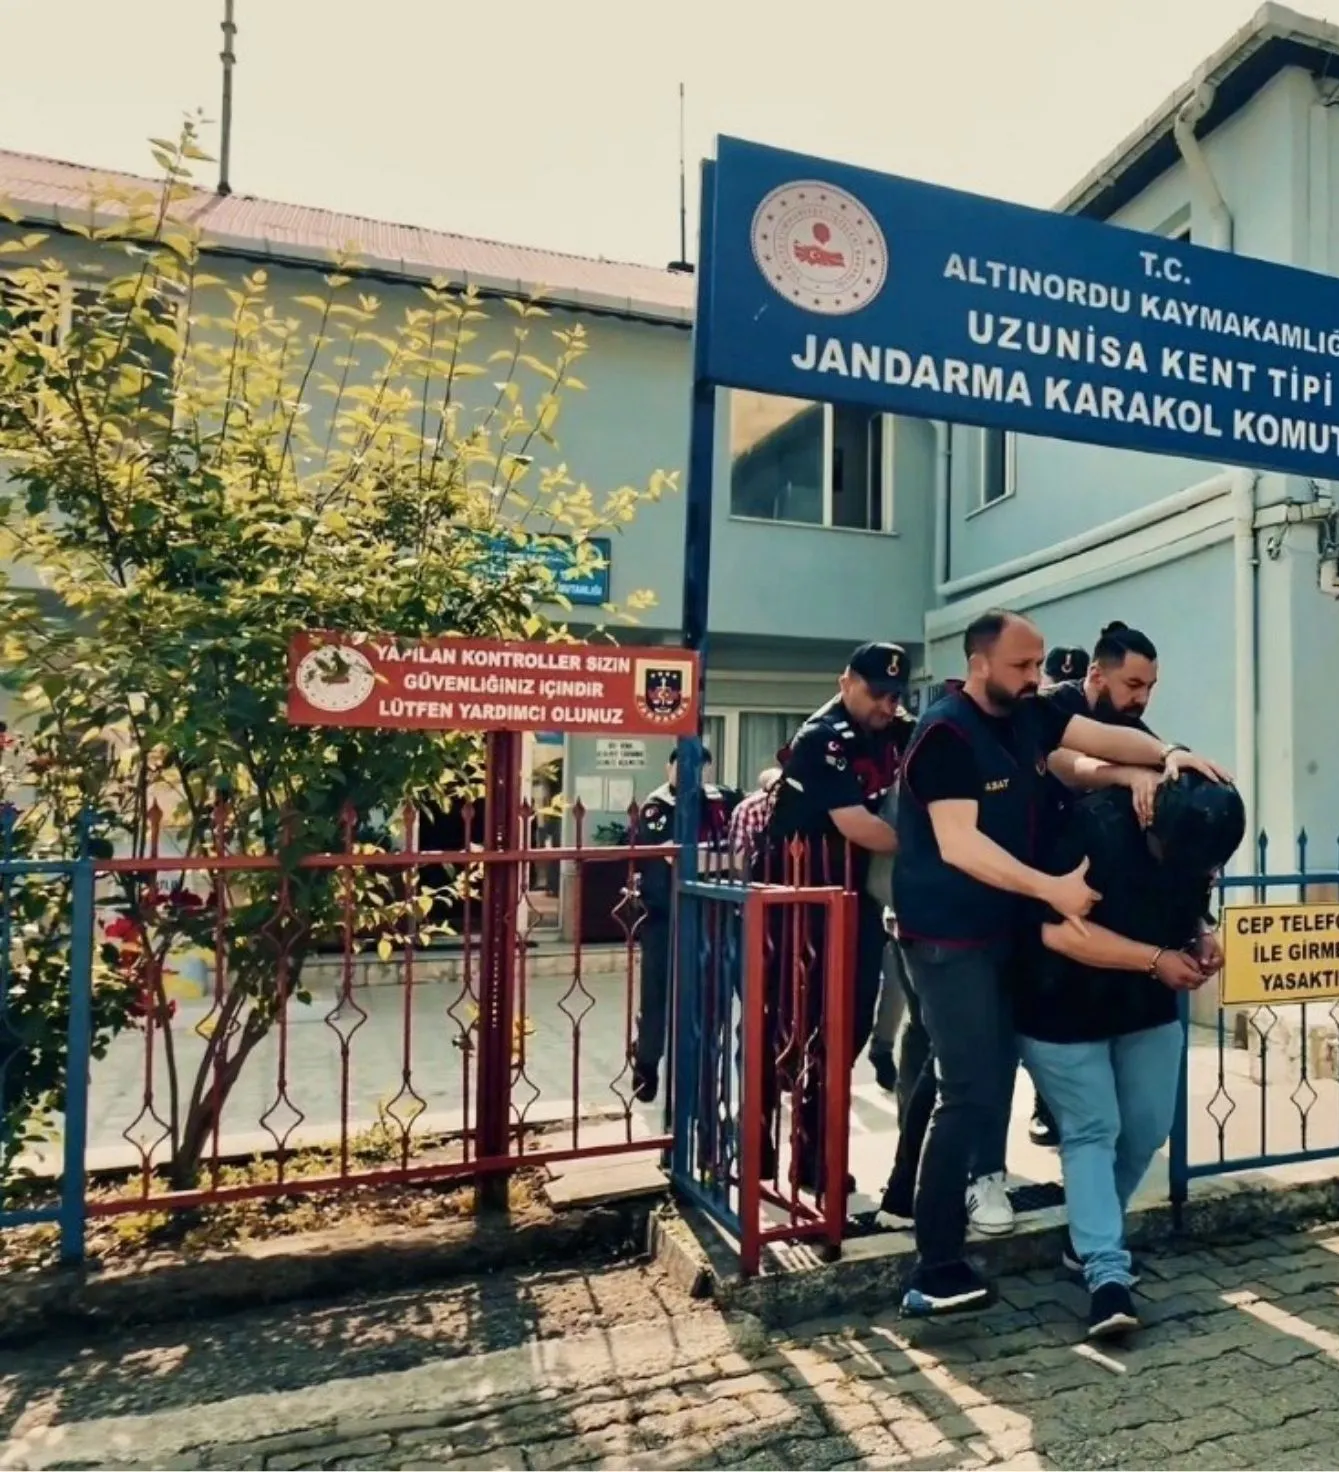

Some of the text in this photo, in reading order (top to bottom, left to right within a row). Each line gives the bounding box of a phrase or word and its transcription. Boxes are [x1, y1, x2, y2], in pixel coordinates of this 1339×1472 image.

[1139, 250, 1191, 284] T.C.
[943, 253, 1131, 313] ALTINORDU
[968, 310, 1332, 406] UZUNİSA KENT TİPİ
[791, 335, 1032, 406] JANDARMA
[1045, 376, 1223, 437] KARAKOL
[461, 649, 581, 671] KONTROLLER
[379, 697, 624, 724] LÜTFEN YARDIMCI OLUNUZ
[1236, 916, 1274, 935] CEP
[1253, 942, 1282, 962] İLE
